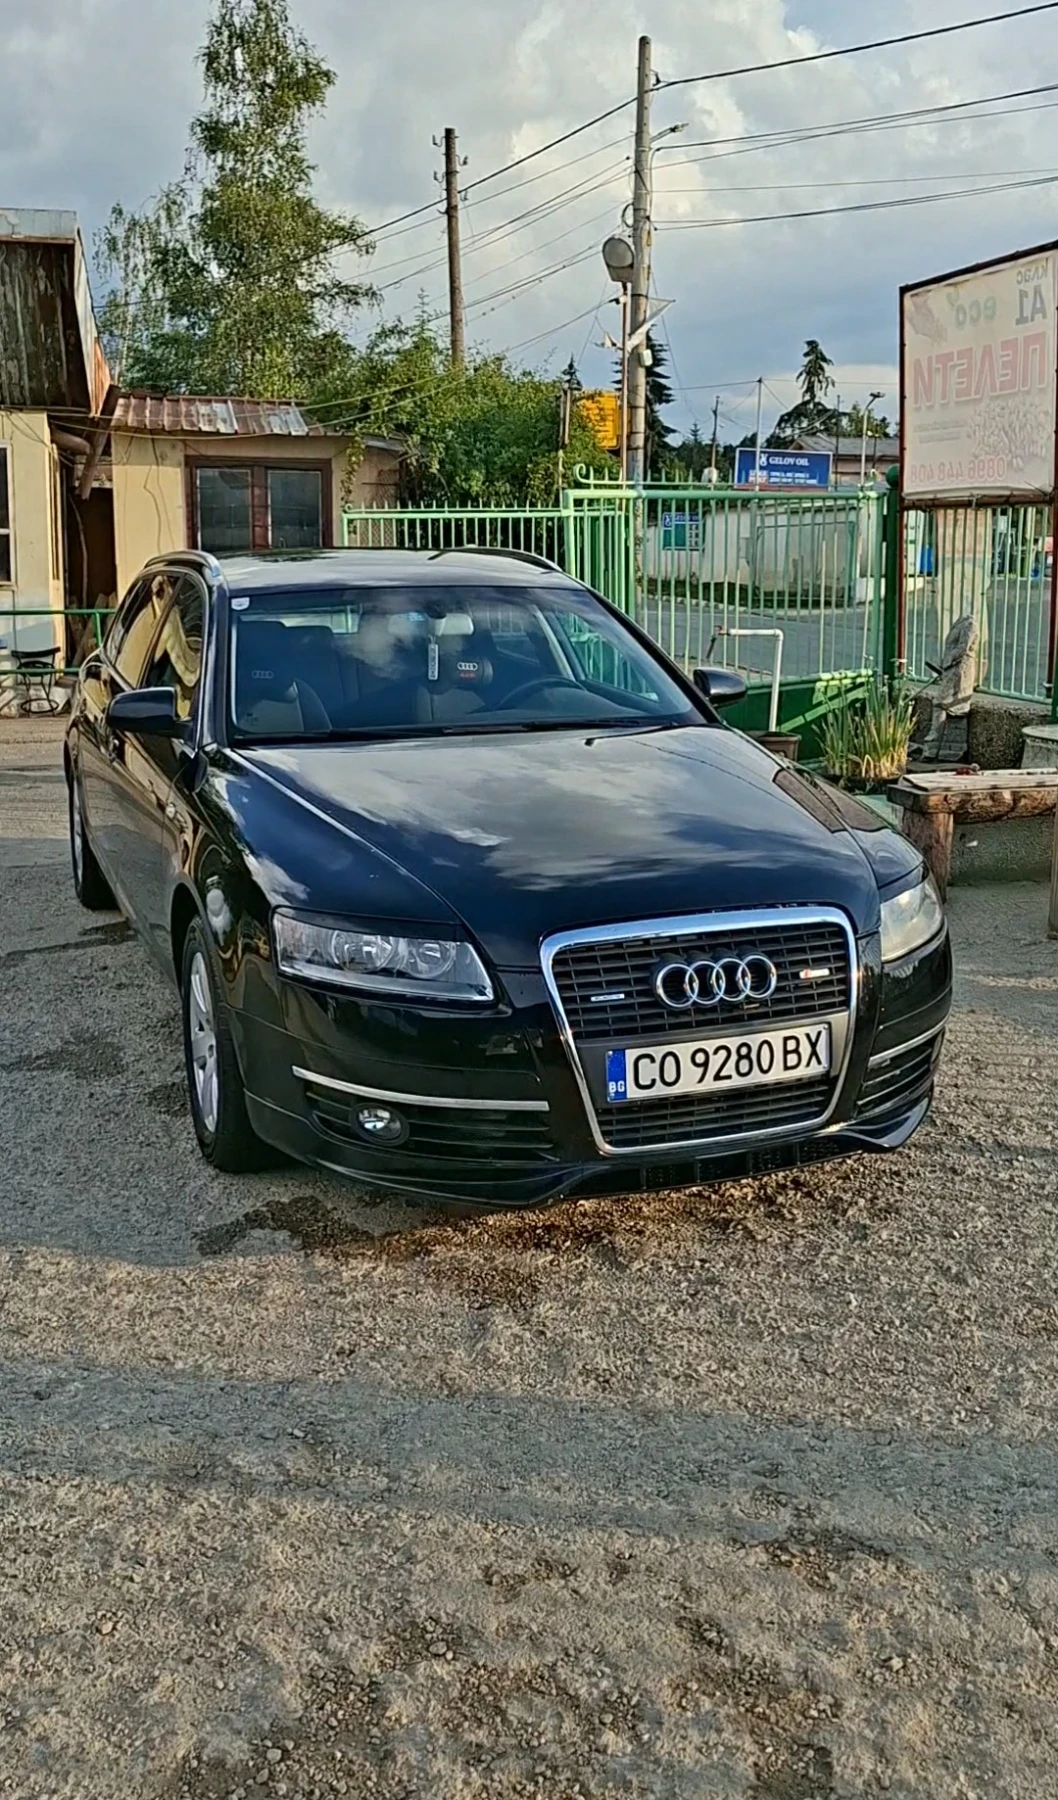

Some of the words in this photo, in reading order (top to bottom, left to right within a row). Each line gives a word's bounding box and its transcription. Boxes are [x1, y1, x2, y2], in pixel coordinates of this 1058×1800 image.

[633, 1051, 681, 1090] CO
[690, 1040, 775, 1084] 9280
[782, 1030, 823, 1072] BX
[608, 1081, 625, 1092] BG
